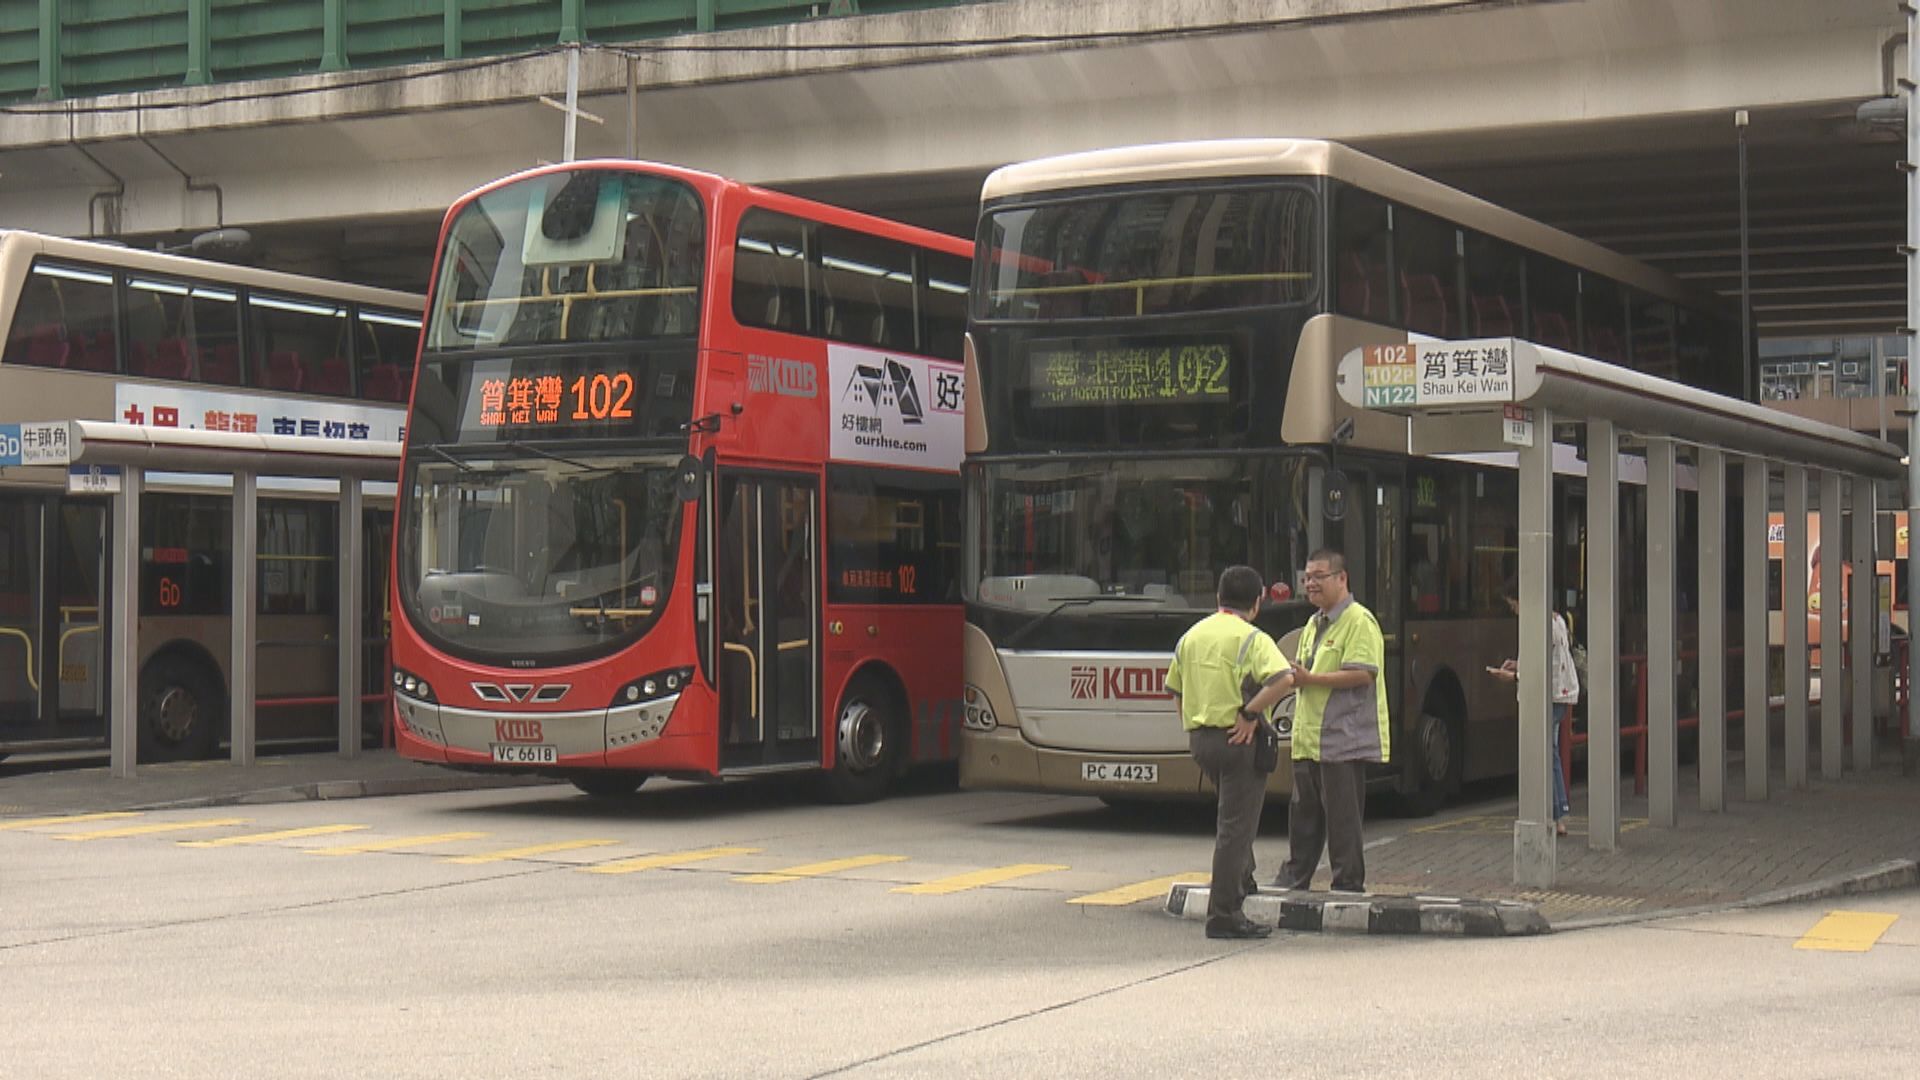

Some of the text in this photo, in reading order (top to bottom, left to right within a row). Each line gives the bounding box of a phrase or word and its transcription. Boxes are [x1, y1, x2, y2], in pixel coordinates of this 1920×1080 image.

[1373, 347, 1407, 364] 102
[1423, 348, 1508, 379] 筲箕灣
[768, 357, 818, 398] KMB
[1371, 366, 1415, 384] 102P
[480, 373, 633, 419] 筲箕灣 102
[936, 372, 965, 410] 好
[1367, 387, 1415, 405] N122
[1423, 378, 1509, 396] Shau Kei Wan
[480, 410, 558, 425] SHAU KEI WAN
[841, 412, 882, 434] 好樓網
[0, 433, 20, 457] 6D
[23, 428, 67, 447] 牛頭角
[898, 564, 916, 594] 102
[160, 577, 180, 606] 6D
[495, 719, 544, 743] KMB
[499, 747, 552, 761] VC 6618
[1087, 764, 1154, 781] PC 4423
